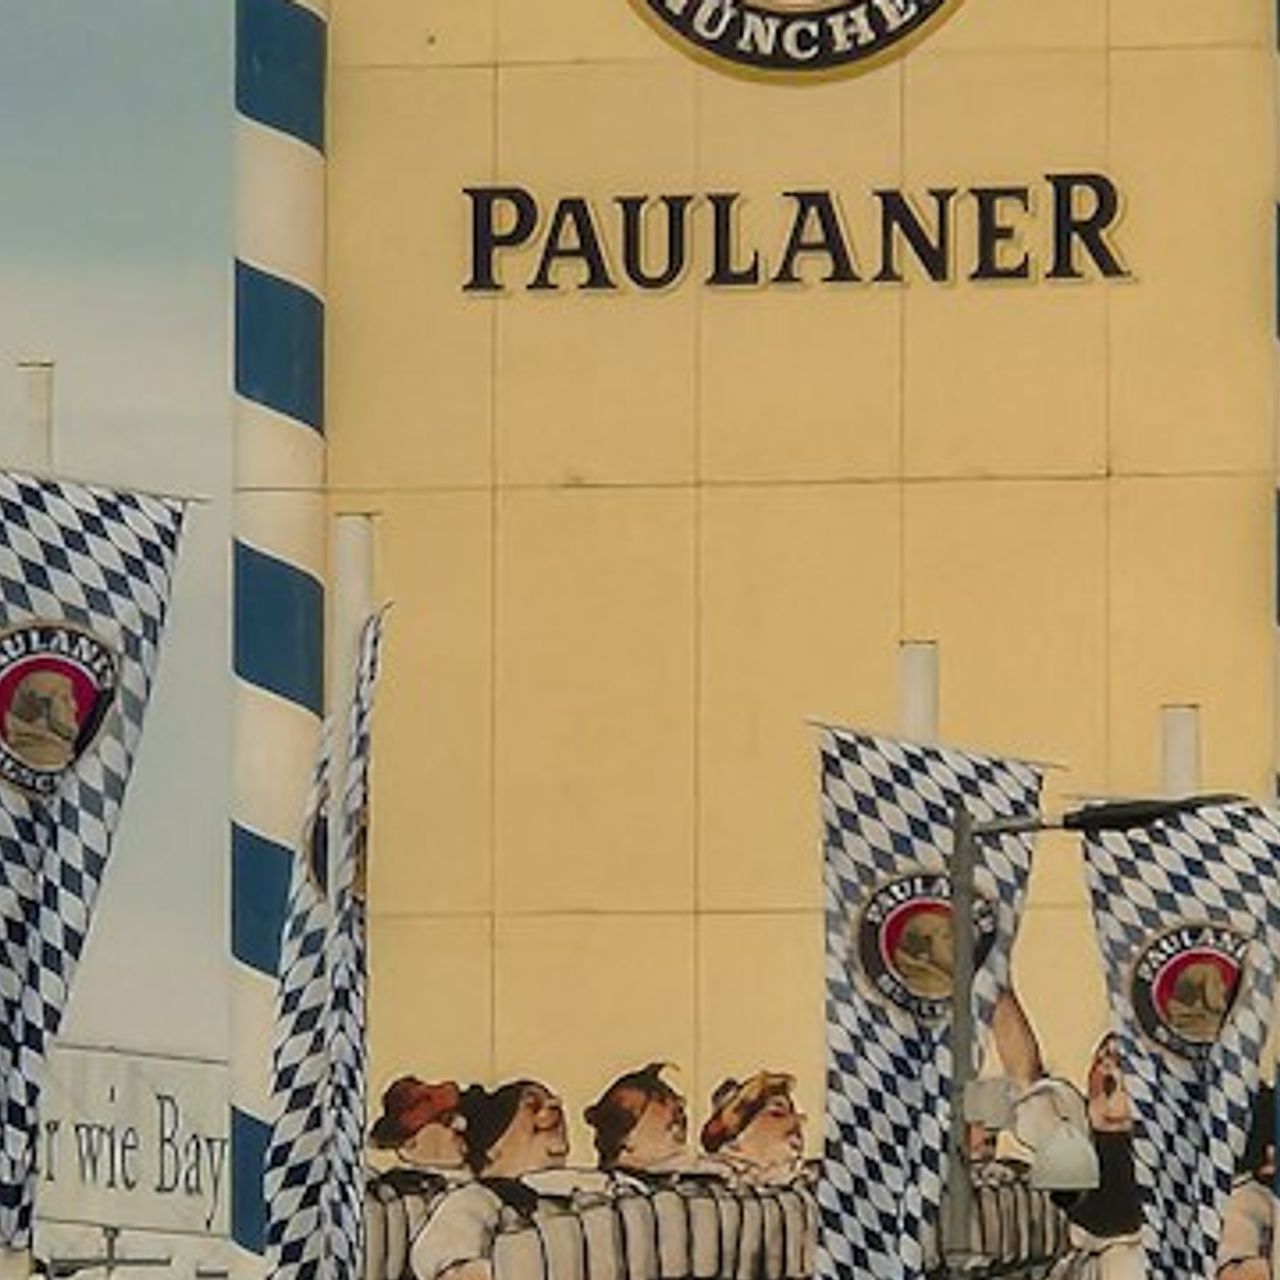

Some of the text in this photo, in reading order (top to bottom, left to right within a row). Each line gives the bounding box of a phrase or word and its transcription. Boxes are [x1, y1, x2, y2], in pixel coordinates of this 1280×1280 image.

[462, 173, 1132, 291] PAULANER
[75, 1085, 141, 1191] wie
[156, 1093, 228, 1230] Bay
